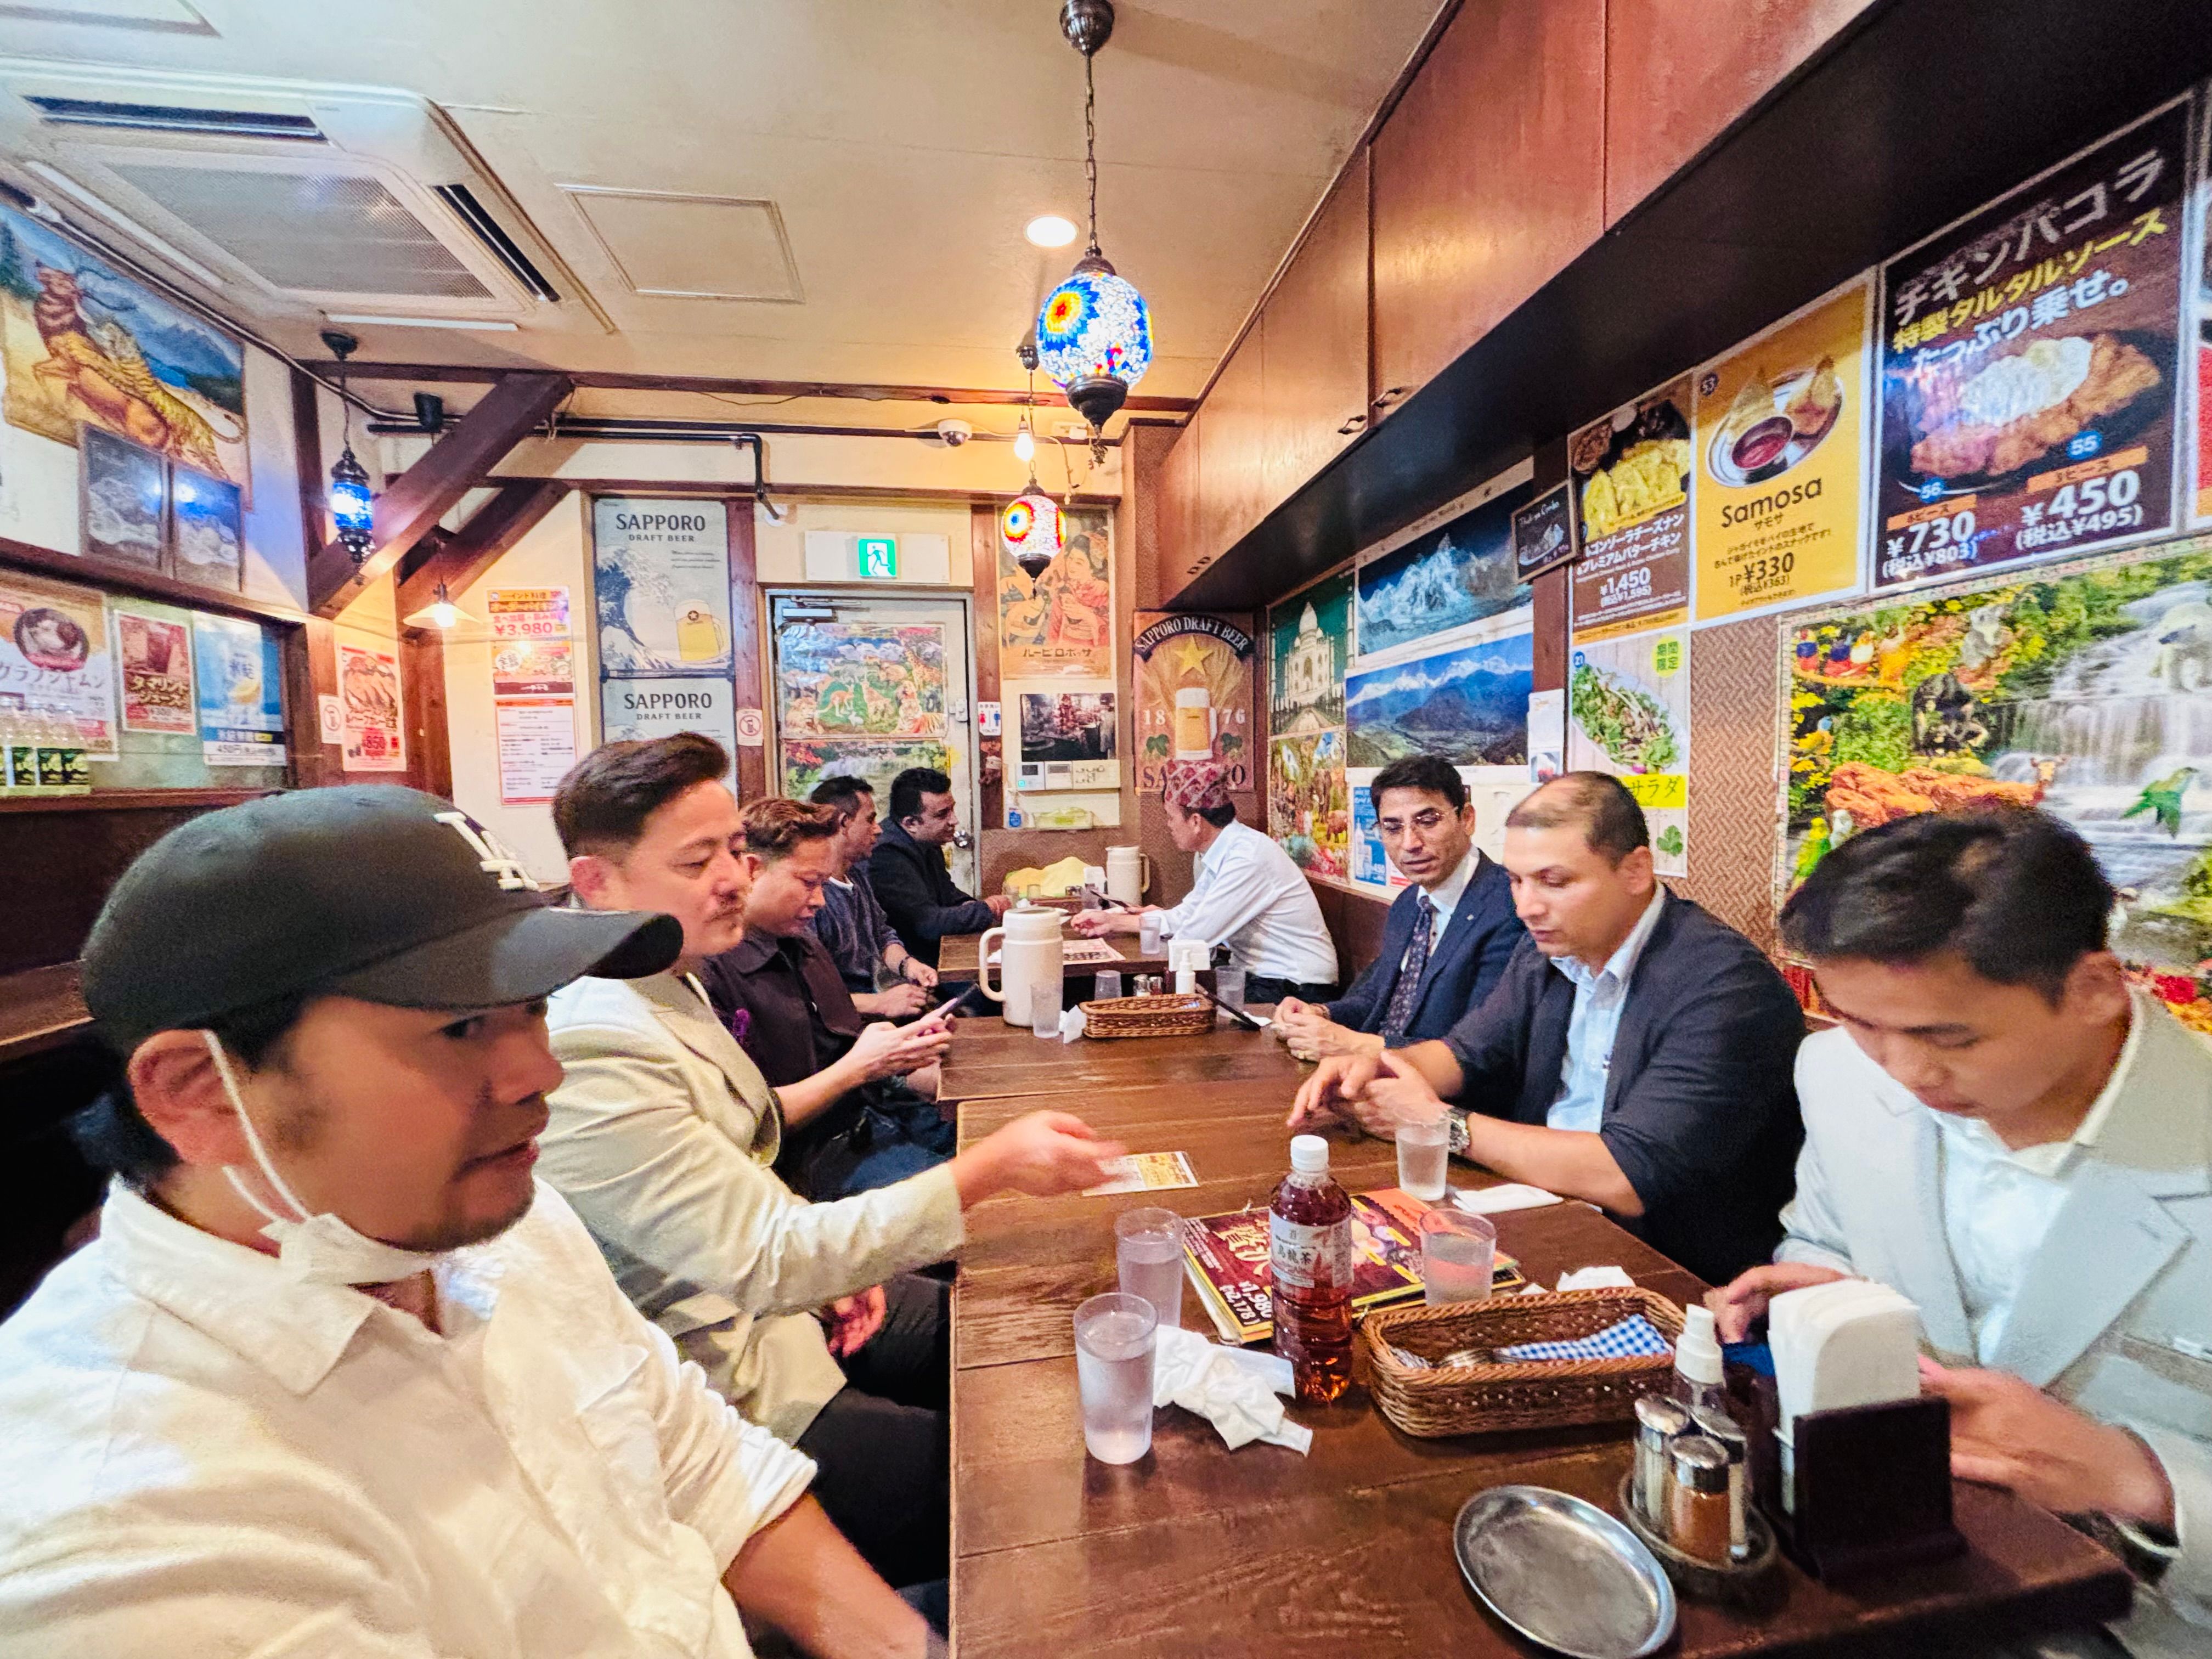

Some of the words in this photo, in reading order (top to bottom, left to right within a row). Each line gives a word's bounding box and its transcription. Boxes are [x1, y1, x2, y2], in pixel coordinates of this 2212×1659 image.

[1894, 148, 2165, 326] チキンパコラ
[2071, 436, 2098, 456] 55
[1722, 477, 1822, 528] Samosa
[2021, 469, 2140, 527] ¥450
[616, 514, 706, 531] SAPPORO
[1887, 510, 1977, 558] ¥730
[2016, 505, 2143, 550] (税込¥495)
[1600, 567, 1651, 596] ¥1,450
[1743, 552, 1795, 583] ¥330
[495, 622, 552, 636] ¥3,980
[1134, 618, 1182, 651] SAPPORO
[1183, 616, 1220, 634] DRAFT
[1220, 625, 1249, 651] BEER
[624, 693, 712, 709] SAPPORO
[1144, 709, 1166, 725] 18
[1222, 709, 1246, 724] 76
